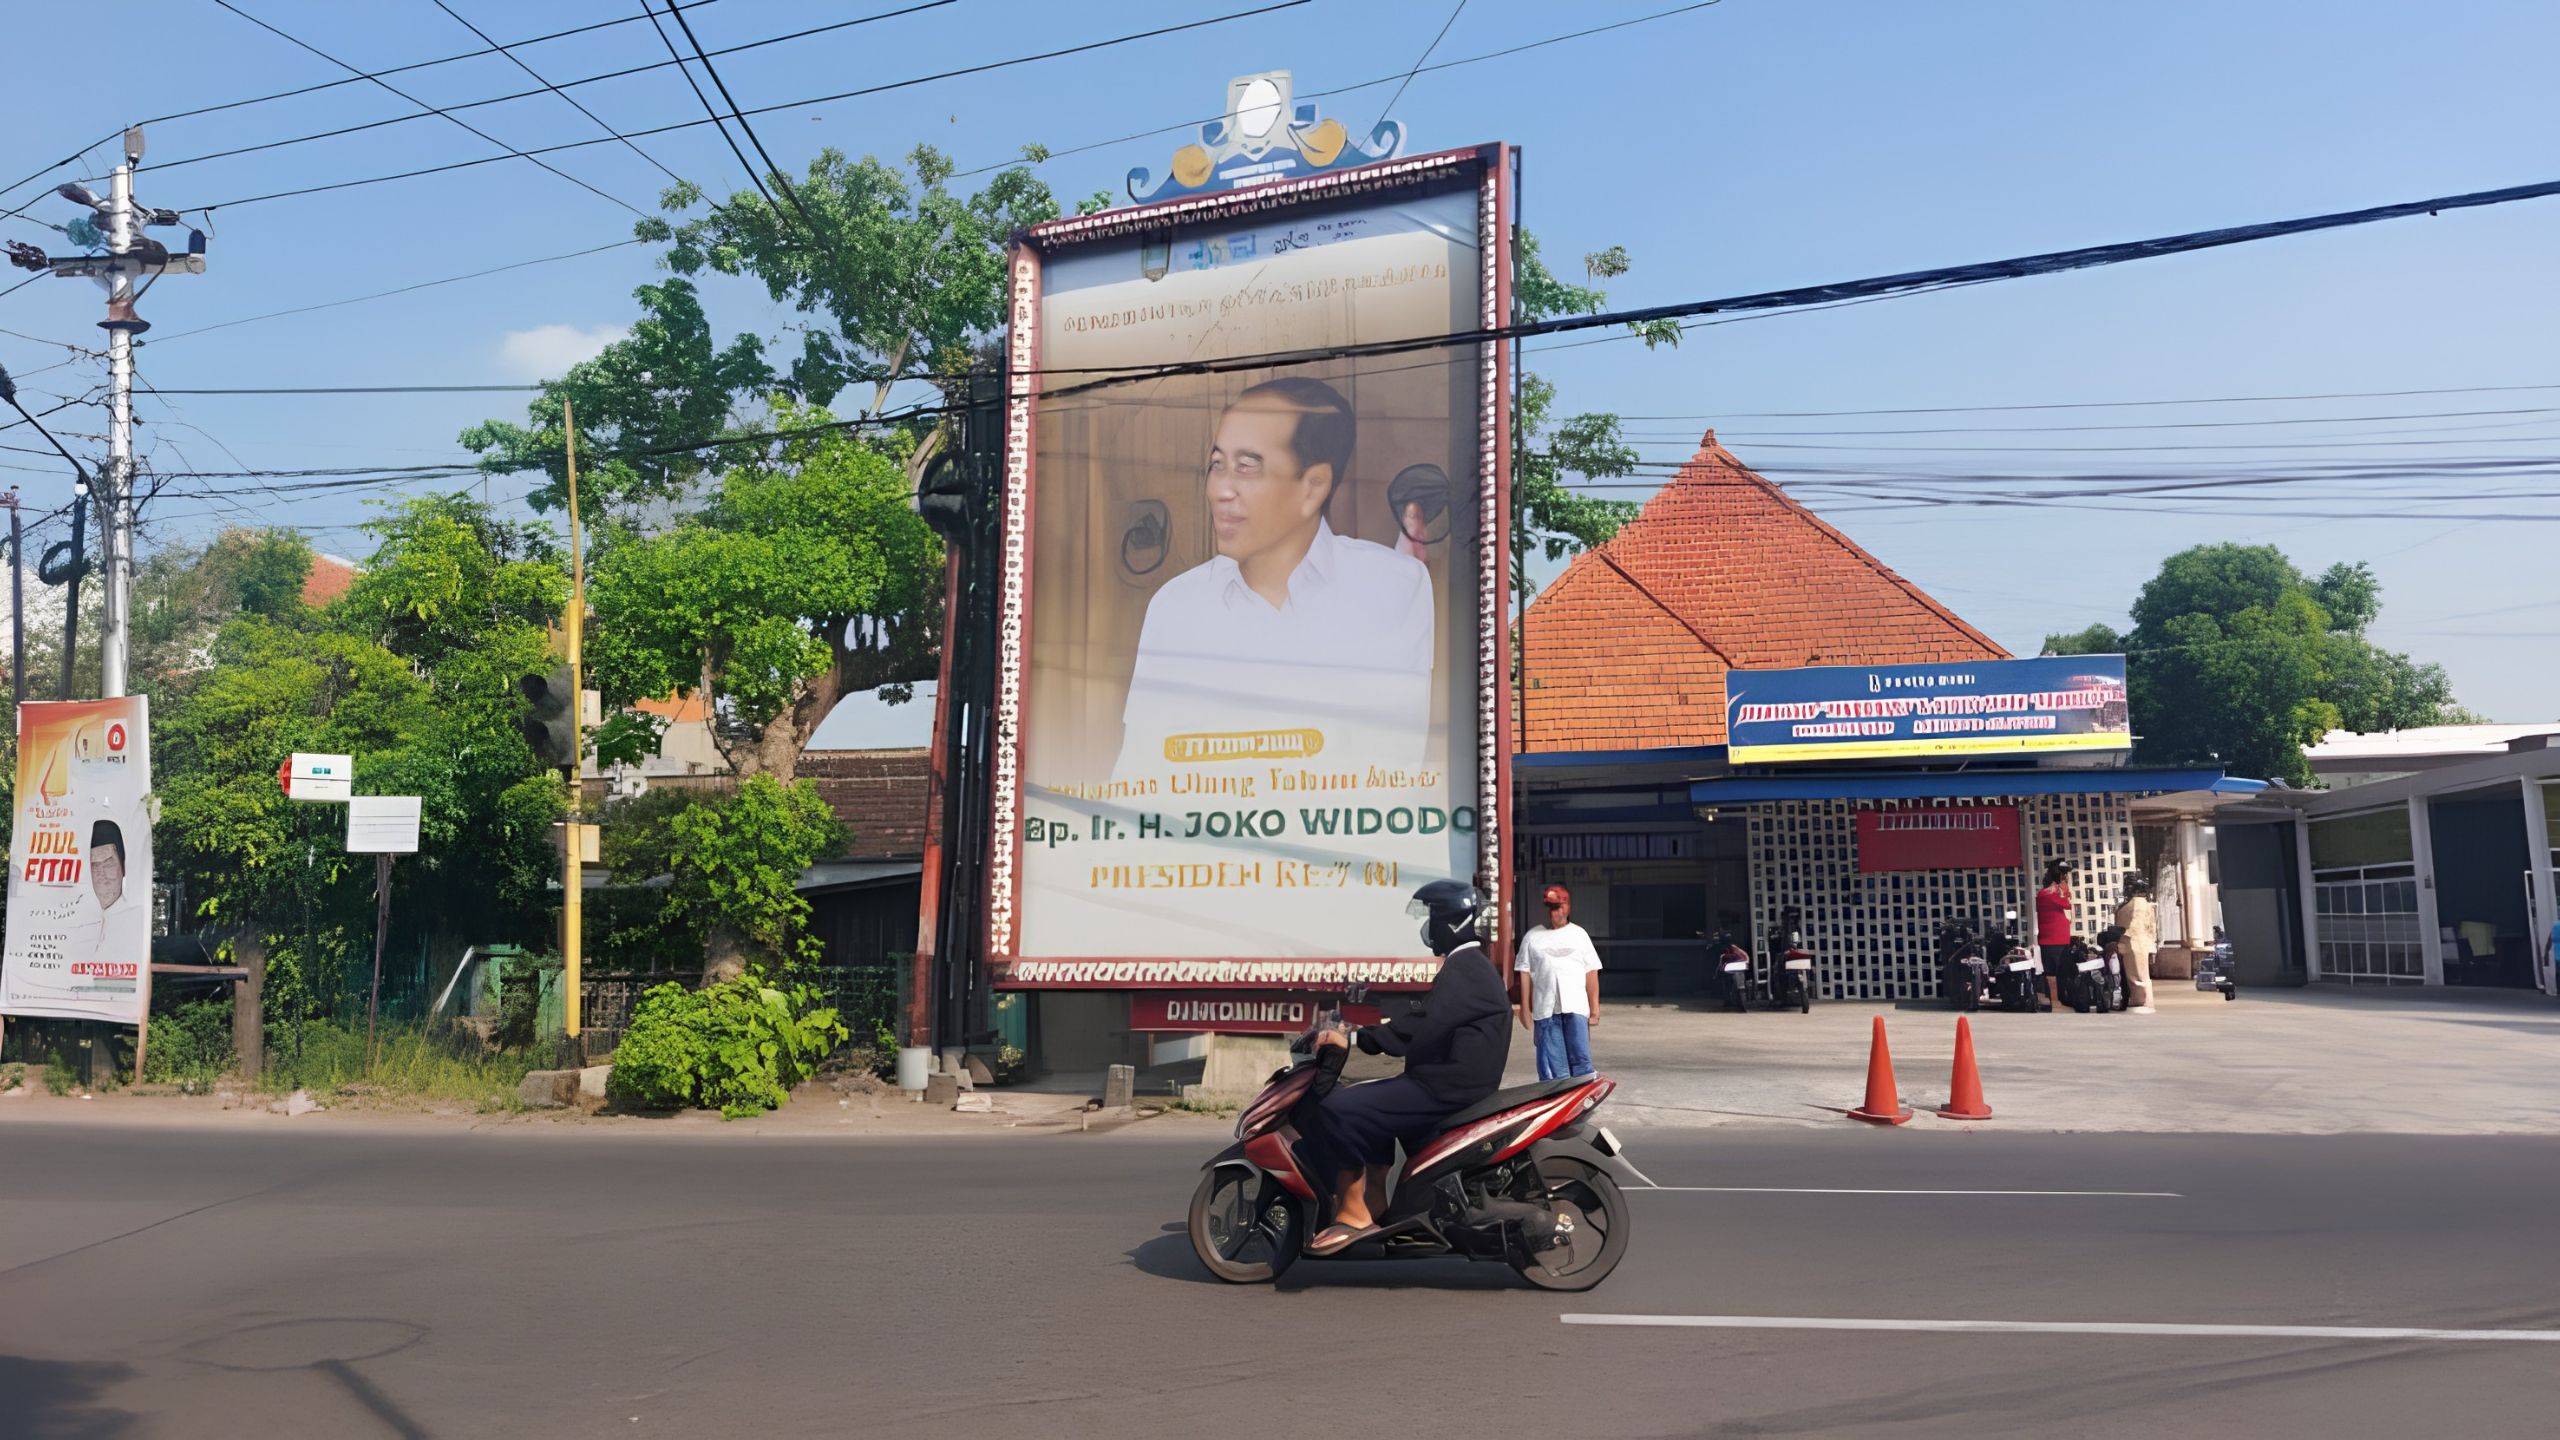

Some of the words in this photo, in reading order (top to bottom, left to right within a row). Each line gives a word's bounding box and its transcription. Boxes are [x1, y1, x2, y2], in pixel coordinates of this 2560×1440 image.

[1091, 814, 1126, 840] Ir.
[1139, 812, 1174, 839] H.
[1184, 808, 1287, 839] JOKO
[1299, 805, 1478, 837] WIDODO
[29, 831, 79, 855] IDUL
